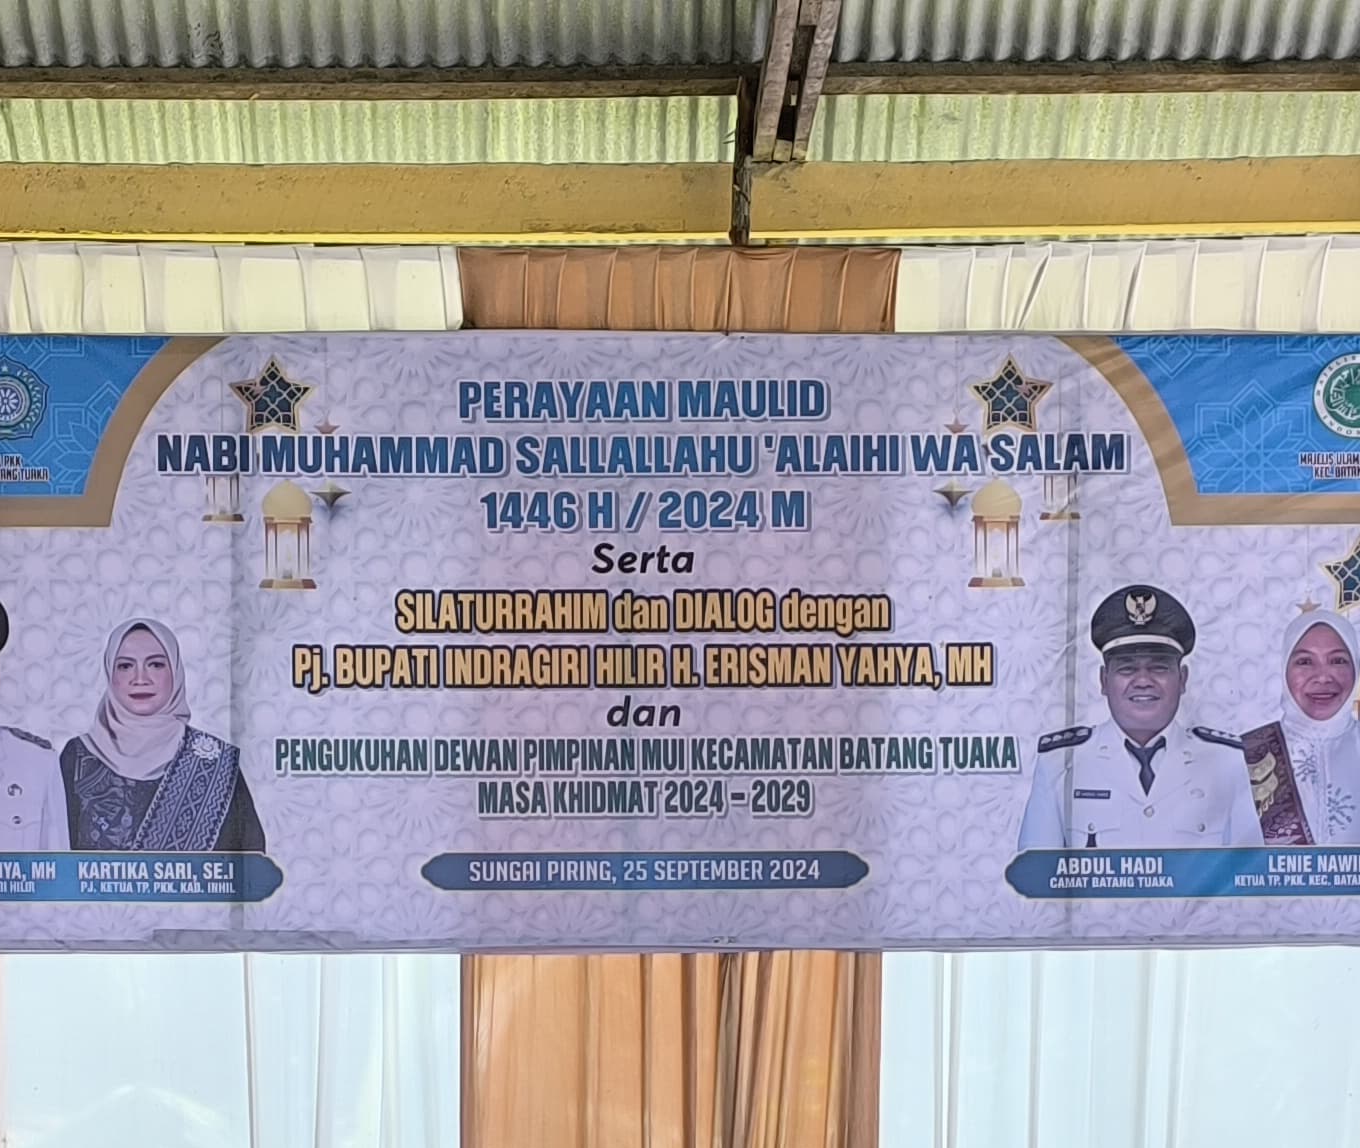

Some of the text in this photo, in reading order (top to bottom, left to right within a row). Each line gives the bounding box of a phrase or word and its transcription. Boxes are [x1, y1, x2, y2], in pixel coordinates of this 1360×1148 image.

[459, 379, 826, 419] PERAYAAN MAULID
[157, 434, 1126, 474] NABI MUHAMMAD SALLALLAHU 'ALAIHI WA SALAM
[1300, 453, 1334, 465] MAJELIS
[480, 491, 806, 530] 1446 H / 2024 M
[592, 542, 695, 574] Serta
[397, 589, 891, 635] SILATURRAHIM dan DIALOG dengan
[293, 643, 993, 693] Pj. BUPATI INDRAGIRI HILIR H. ERISMAN YAHYA, MH
[607, 695, 682, 727] dan
[276, 736, 1018, 772] PENGUKUHAN DEWAN PIMPINAN MUI KECAMATAN BATANG TUAKA
[478, 781, 544, 815] MASA
[554, 780, 659, 814] KHIDMAT
[664, 780, 724, 813] 2024
[751, 780, 811, 813] 2029
[31, 861, 56, 880] MH
[78, 861, 149, 880] KARTIKA
[153, 861, 197, 882] SARI,
[469, 859, 821, 886] SUNGAI PIRING, 25 SEPTEMBER 2024
[1056, 856, 1164, 875] ABDUL HADI
[1268, 854, 1313, 873] LENIE
[9, 881, 36, 893] HILIR
[100, 881, 133, 893] KETUA
[1049, 875, 1174, 889] CAMAT BATANG TUAKA
[1234, 874, 1266, 887] KETUA
